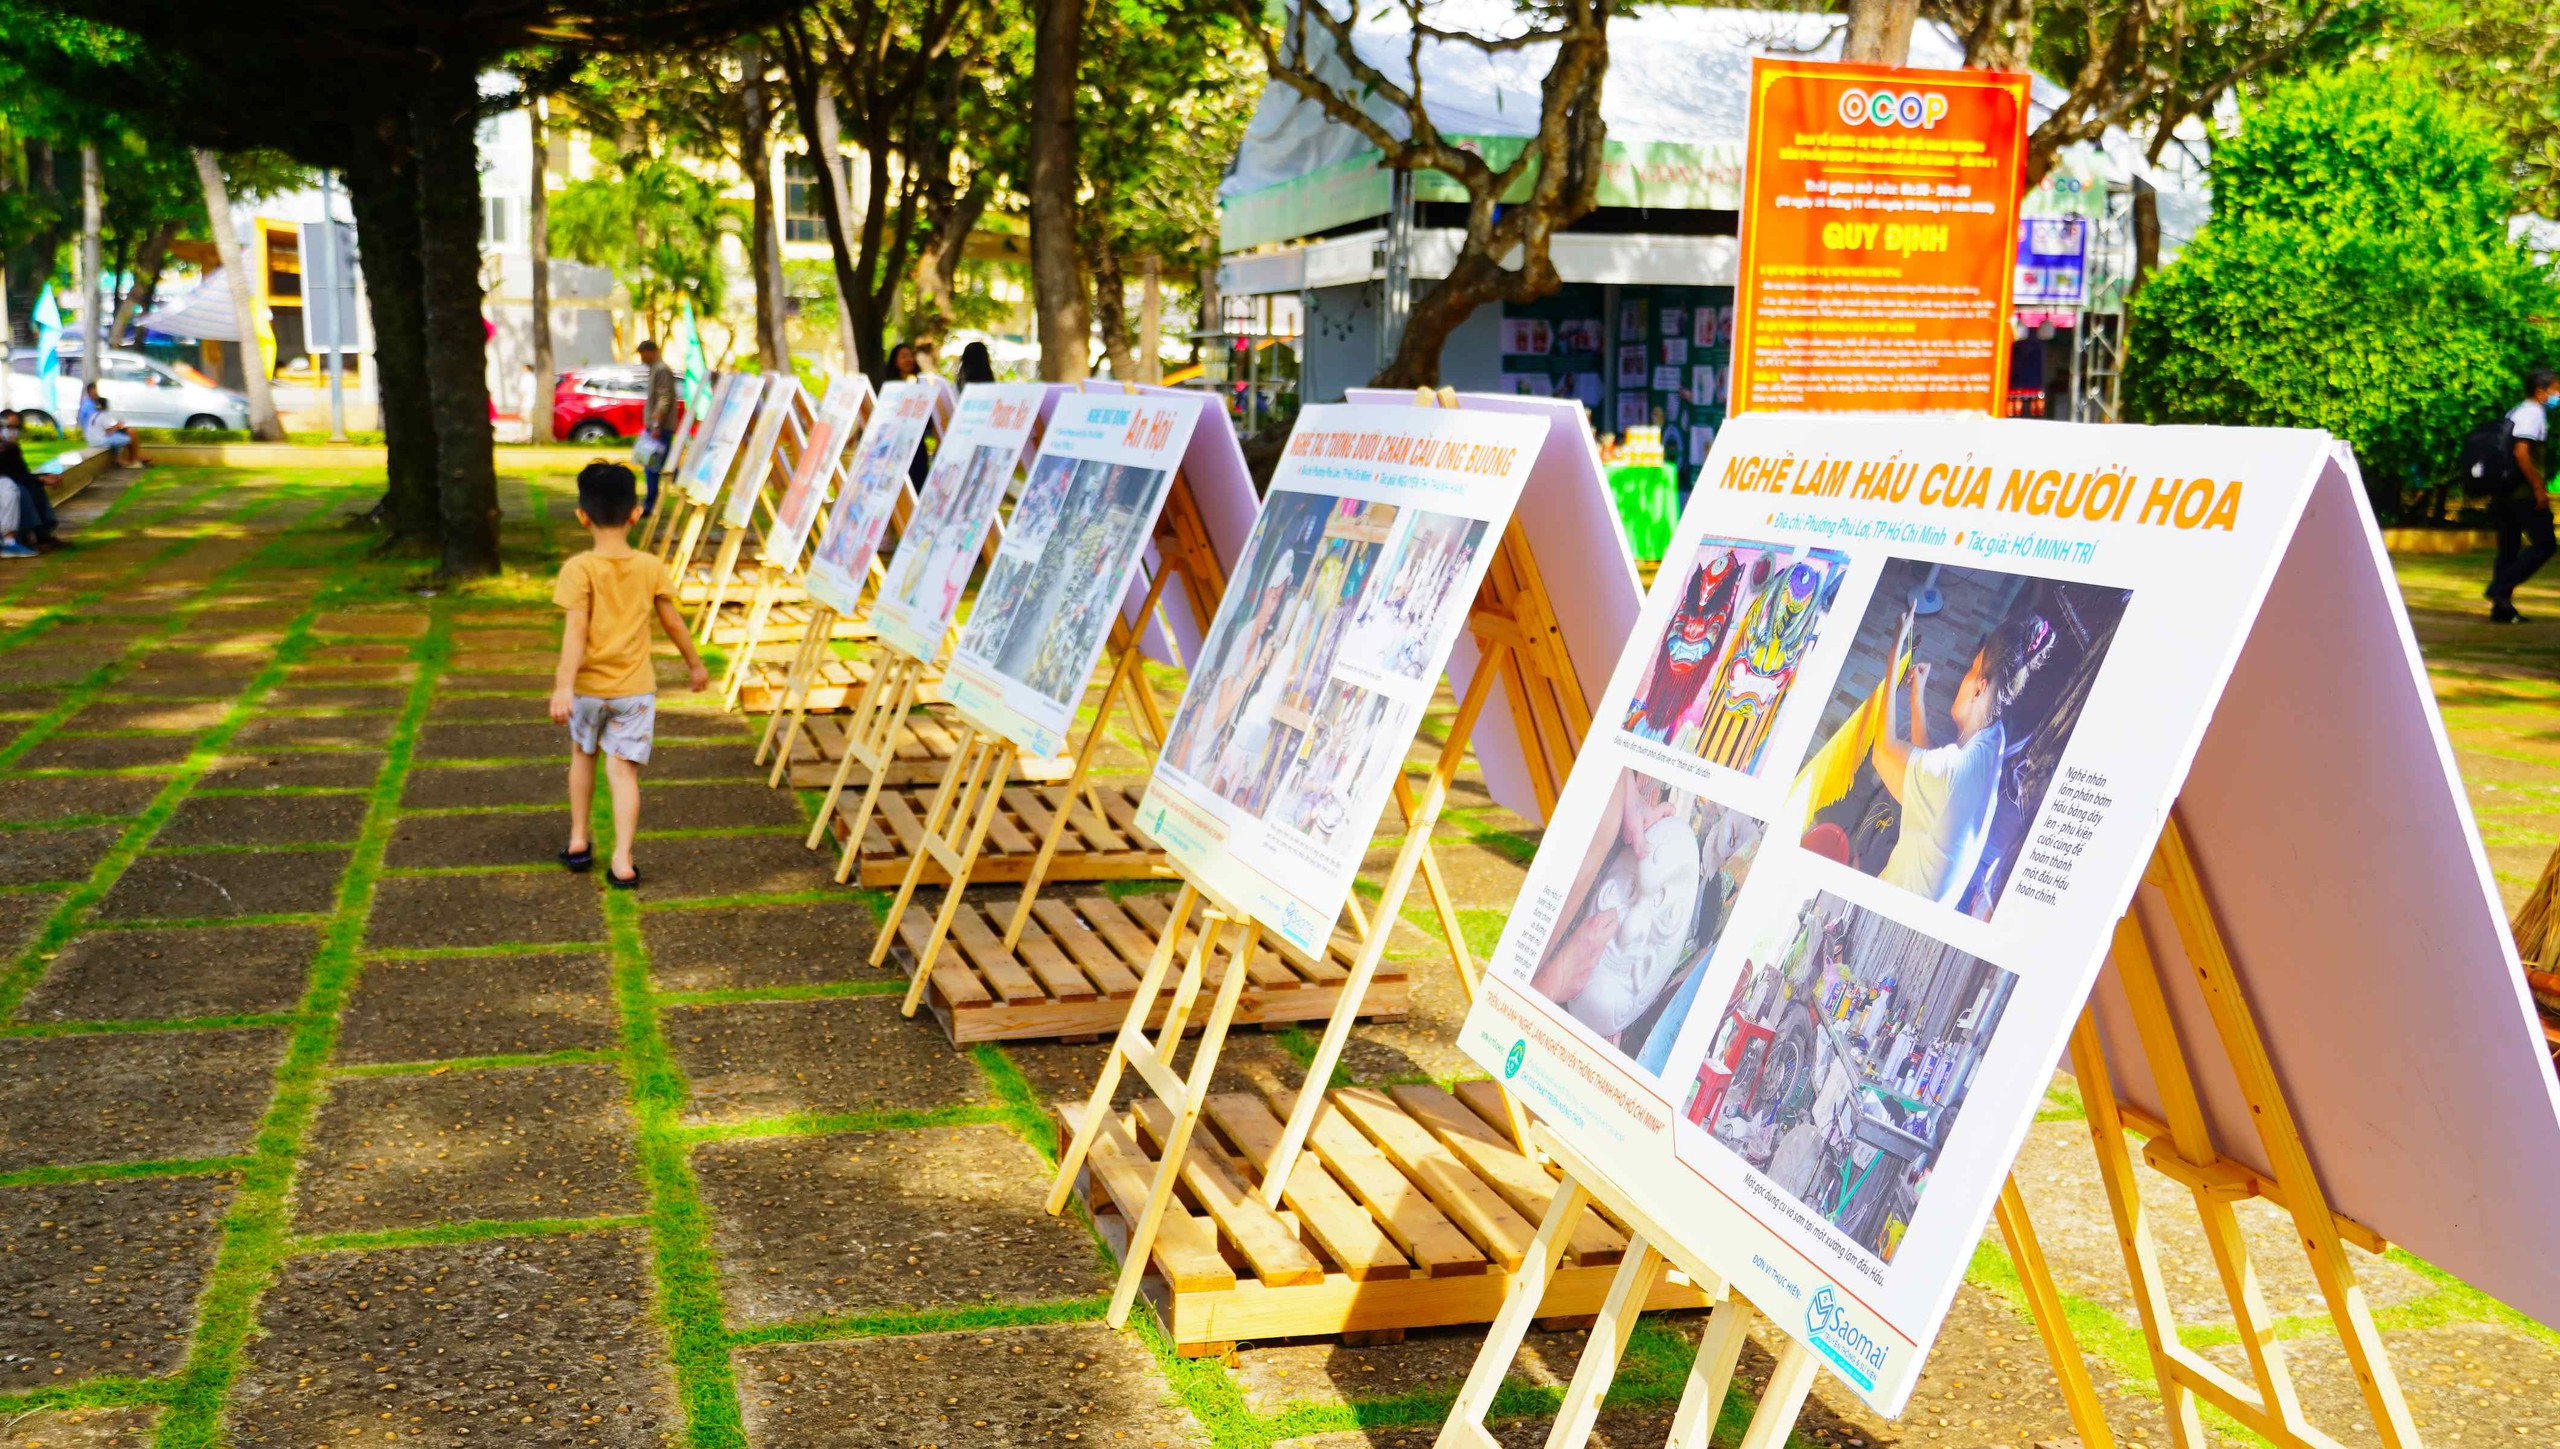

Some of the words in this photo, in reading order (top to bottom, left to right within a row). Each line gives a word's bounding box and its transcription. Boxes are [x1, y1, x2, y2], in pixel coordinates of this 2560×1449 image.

[1839, 88, 1947, 129] OCOP
[1822, 221, 1879, 250] QUY
[1883, 223, 1948, 259] ĐỊNH
[1720, 450, 1794, 494] NGHỀ
[1790, 452, 1852, 497] LÀM
[1919, 452, 1993, 509] CỦA
[1996, 463, 2137, 522] NGƯỜI
[2137, 477, 2243, 531] HOA
[1774, 512, 1789, 533] Địa
[1803, 513, 1837, 539] Phường
[1836, 516, 1857, 536] Phú
[1872, 520, 1887, 539] TP
[1885, 519, 1905, 541] Hồ
[1901, 522, 1922, 543] Chí
[1918, 525, 1947, 546] Minh
[1967, 530, 1988, 551] Tác
[1984, 531, 2011, 558] giả:
[2010, 530, 2037, 557] HỒ
[2032, 538, 2074, 562] MINH
[2072, 539, 2101, 565] TRÍ
[2065, 766, 2088, 787] Nghệ
[2086, 772, 2107, 788] nhân
[2058, 782, 2074, 799] làm
[2072, 788, 2093, 803] phần
[2093, 793, 2112, 808] bờm
[2043, 815, 2057, 830] len
[2058, 821, 2076, 839] phụ
[2075, 825, 2093, 844] kiện
[2067, 803, 2087, 823] bằng
[2087, 809, 2103, 828] dây
[2037, 832, 2054, 848] cuối
[2052, 837, 2073, 856] cùng
[2071, 839, 2086, 857] để
[2029, 849, 2049, 867] hoàn
[2048, 854, 2073, 873] thành
[2022, 866, 2040, 883] một
[2037, 869, 2054, 886] đầu
[2015, 879, 2036, 898] hoàn
[2034, 888, 2057, 906] chỉnh.
[1577, 1060, 1596, 1084] THỐNG
[1593, 1073, 1615, 1099] THÀNH
[1611, 1087, 1627, 1107] PHỐ
[1633, 1104, 1647, 1123] CHÍ
[1743, 1173, 1756, 1189] Một
[1753, 1183, 1766, 1197] góc
[1764, 1188, 1780, 1210] dụng
[1778, 1201, 1788, 1215] cụ
[1786, 1205, 1796, 1218] và
[1793, 1211, 1806, 1229] sơn
[1803, 1220, 1814, 1237] tại
[1812, 1227, 1827, 1246] một
[1844, 1247, 1858, 1266] làm
[1856, 1257, 1870, 1275] đầu
[1752, 1254, 1767, 1270] ĐƠN
[1829, 1306, 1889, 1371] Saomai
